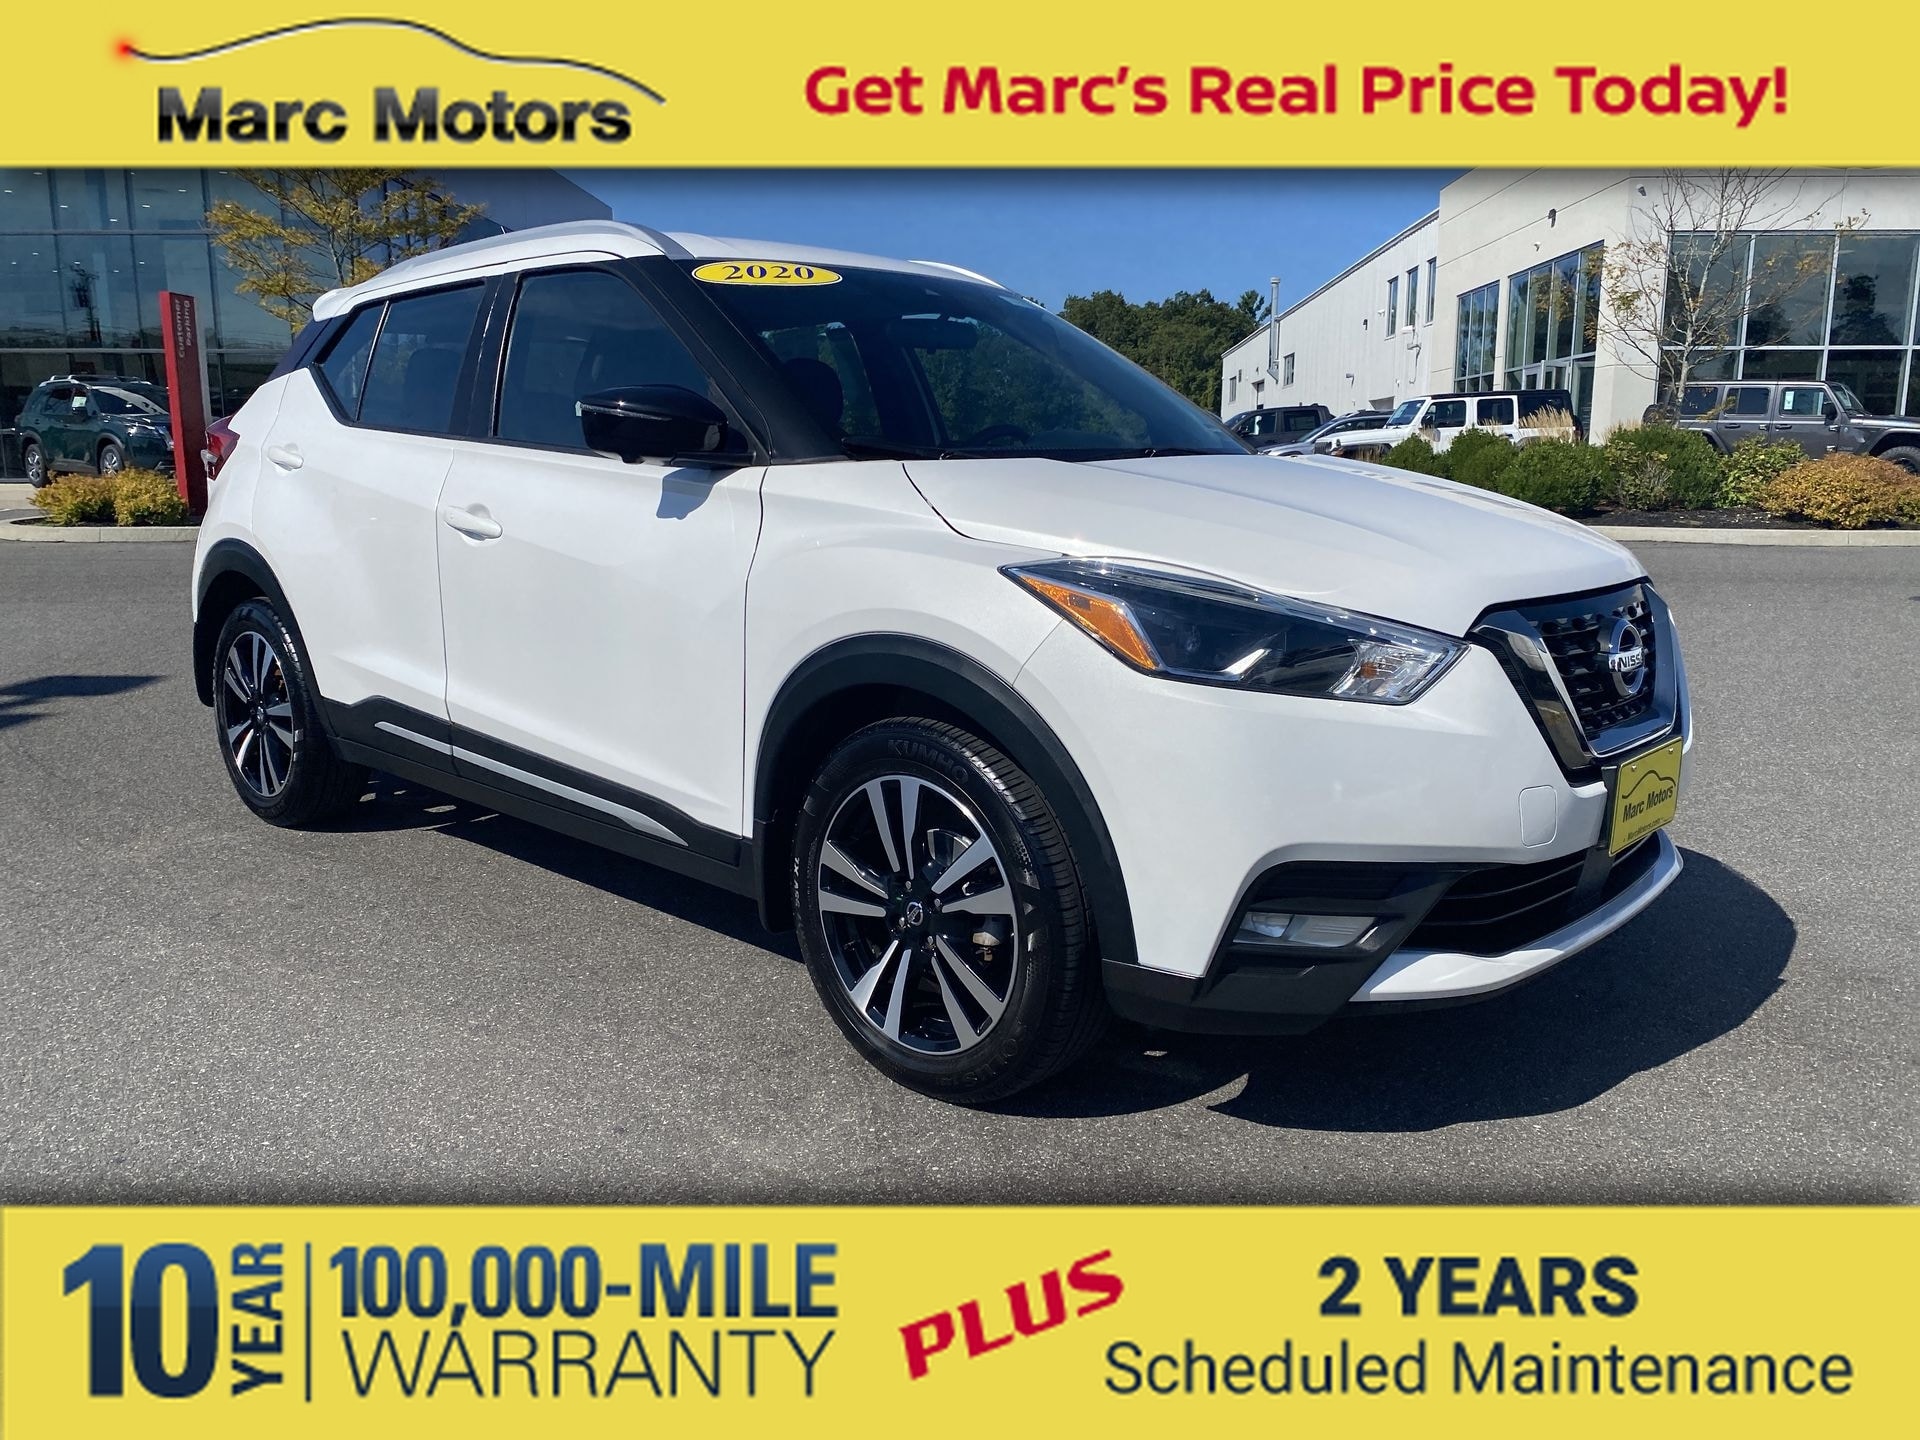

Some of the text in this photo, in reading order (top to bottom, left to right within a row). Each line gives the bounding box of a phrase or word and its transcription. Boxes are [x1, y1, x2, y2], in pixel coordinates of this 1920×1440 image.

[722, 264, 814, 280] 2020
[1622, 785, 1674, 823] Marc Motors
